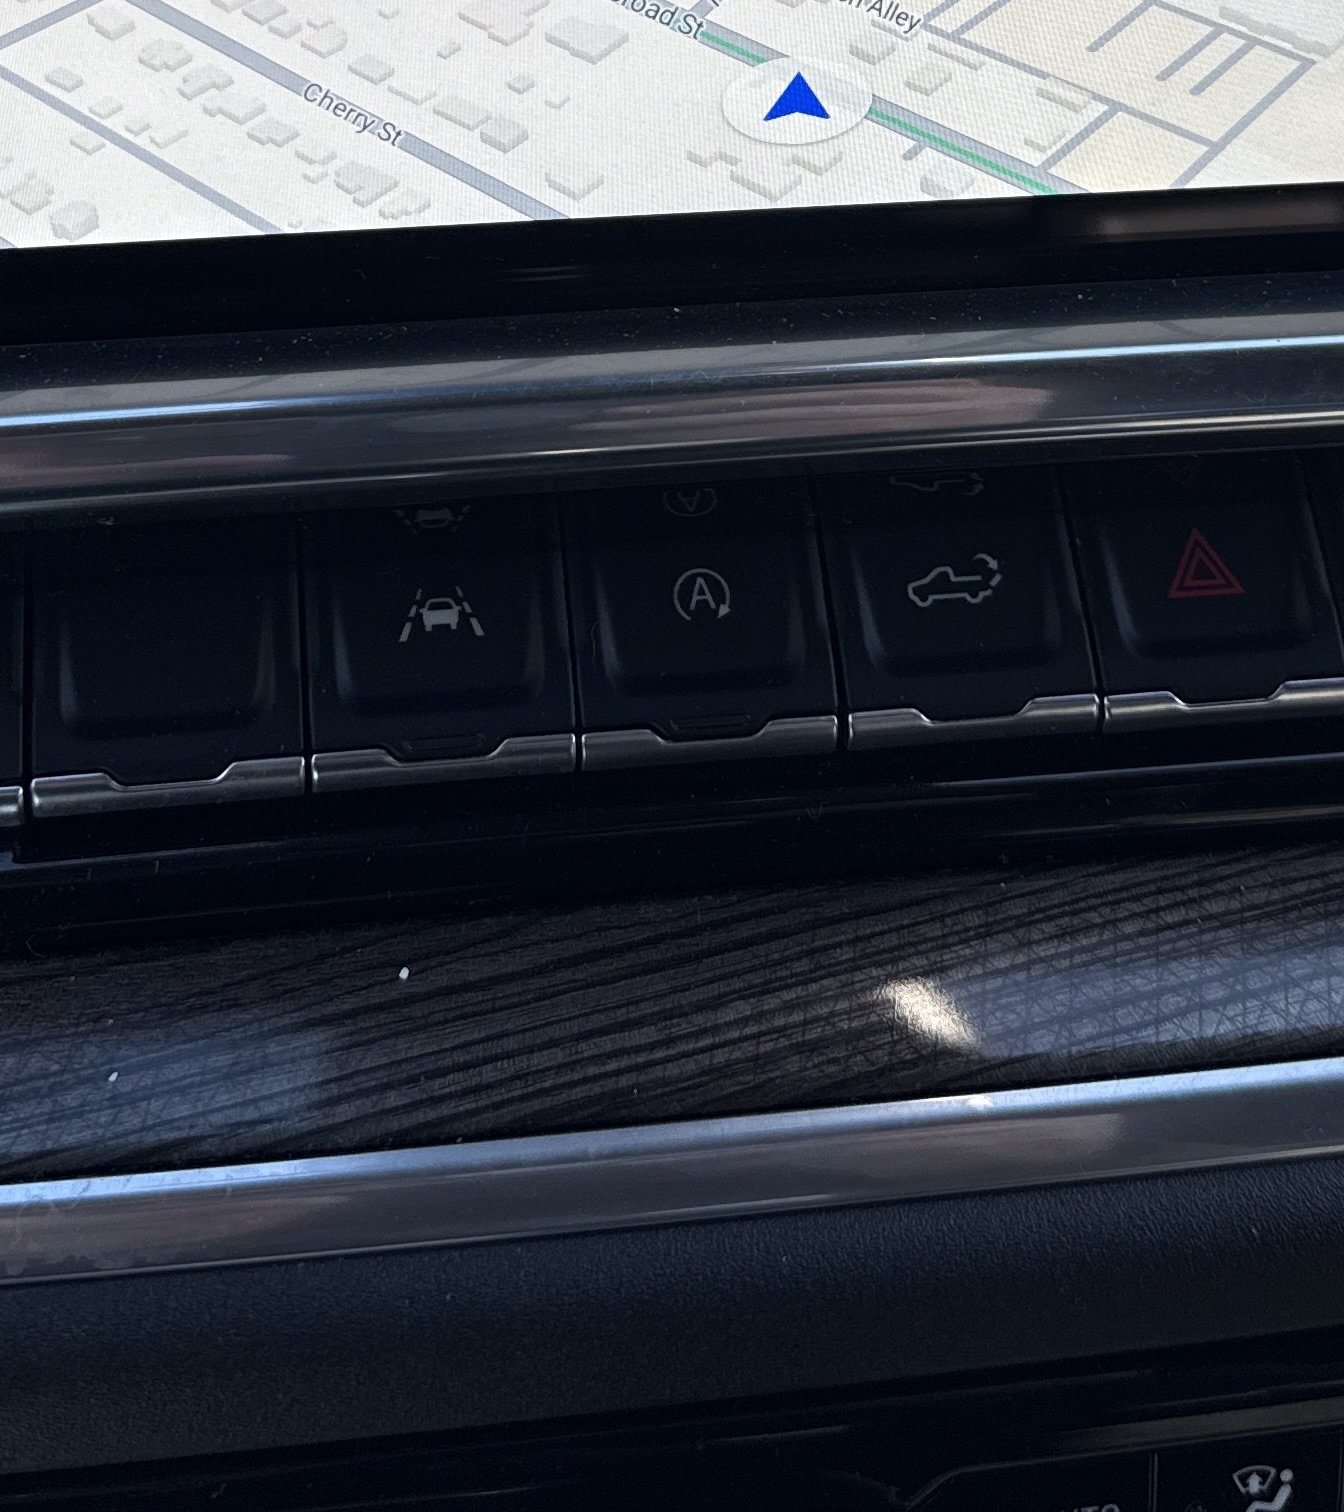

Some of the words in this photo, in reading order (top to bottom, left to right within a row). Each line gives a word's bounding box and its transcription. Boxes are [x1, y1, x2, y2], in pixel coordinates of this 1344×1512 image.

[676, 11, 706, 40] St
[303, 82, 376, 137] Cherry
[376, 121, 404, 147] St
